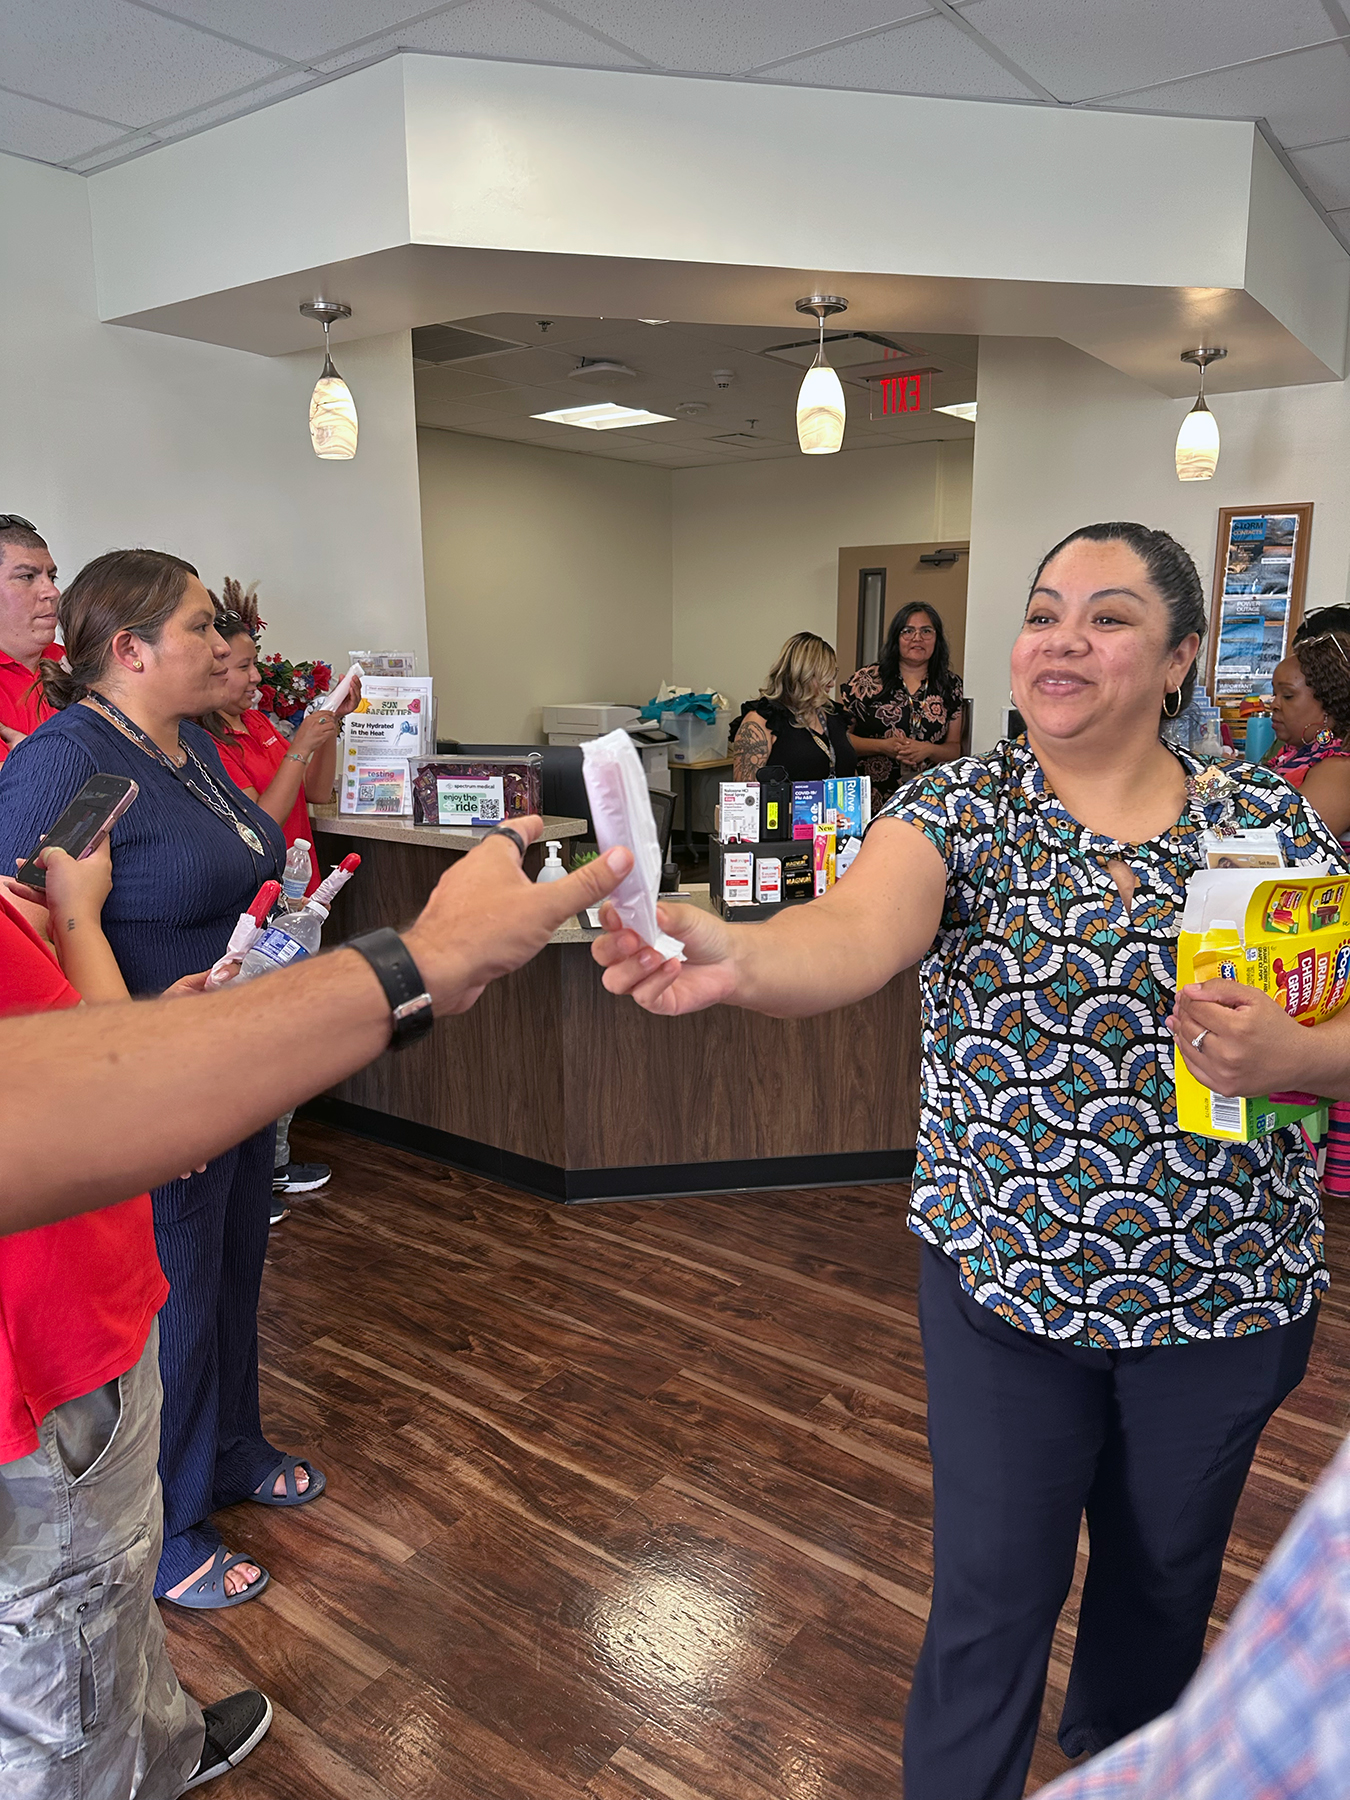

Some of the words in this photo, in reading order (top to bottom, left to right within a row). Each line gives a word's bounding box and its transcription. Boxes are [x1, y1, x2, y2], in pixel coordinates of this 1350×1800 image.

[351, 721, 365, 729] Stay
[368, 771, 395, 779] testing
[443, 794, 462, 802] enjoy
[463, 793, 477, 801] the
[456, 802, 478, 811] ride
[1221, 826, 1237, 836] ASU
[786, 876, 812, 885] MAGNUM
[1300, 957, 1312, 1006] CHERRY
[1312, 957, 1328, 1005] ORANGE
[1327, 947, 1350, 1009] Popsicle
[1288, 974, 1299, 1015] GRAPE
